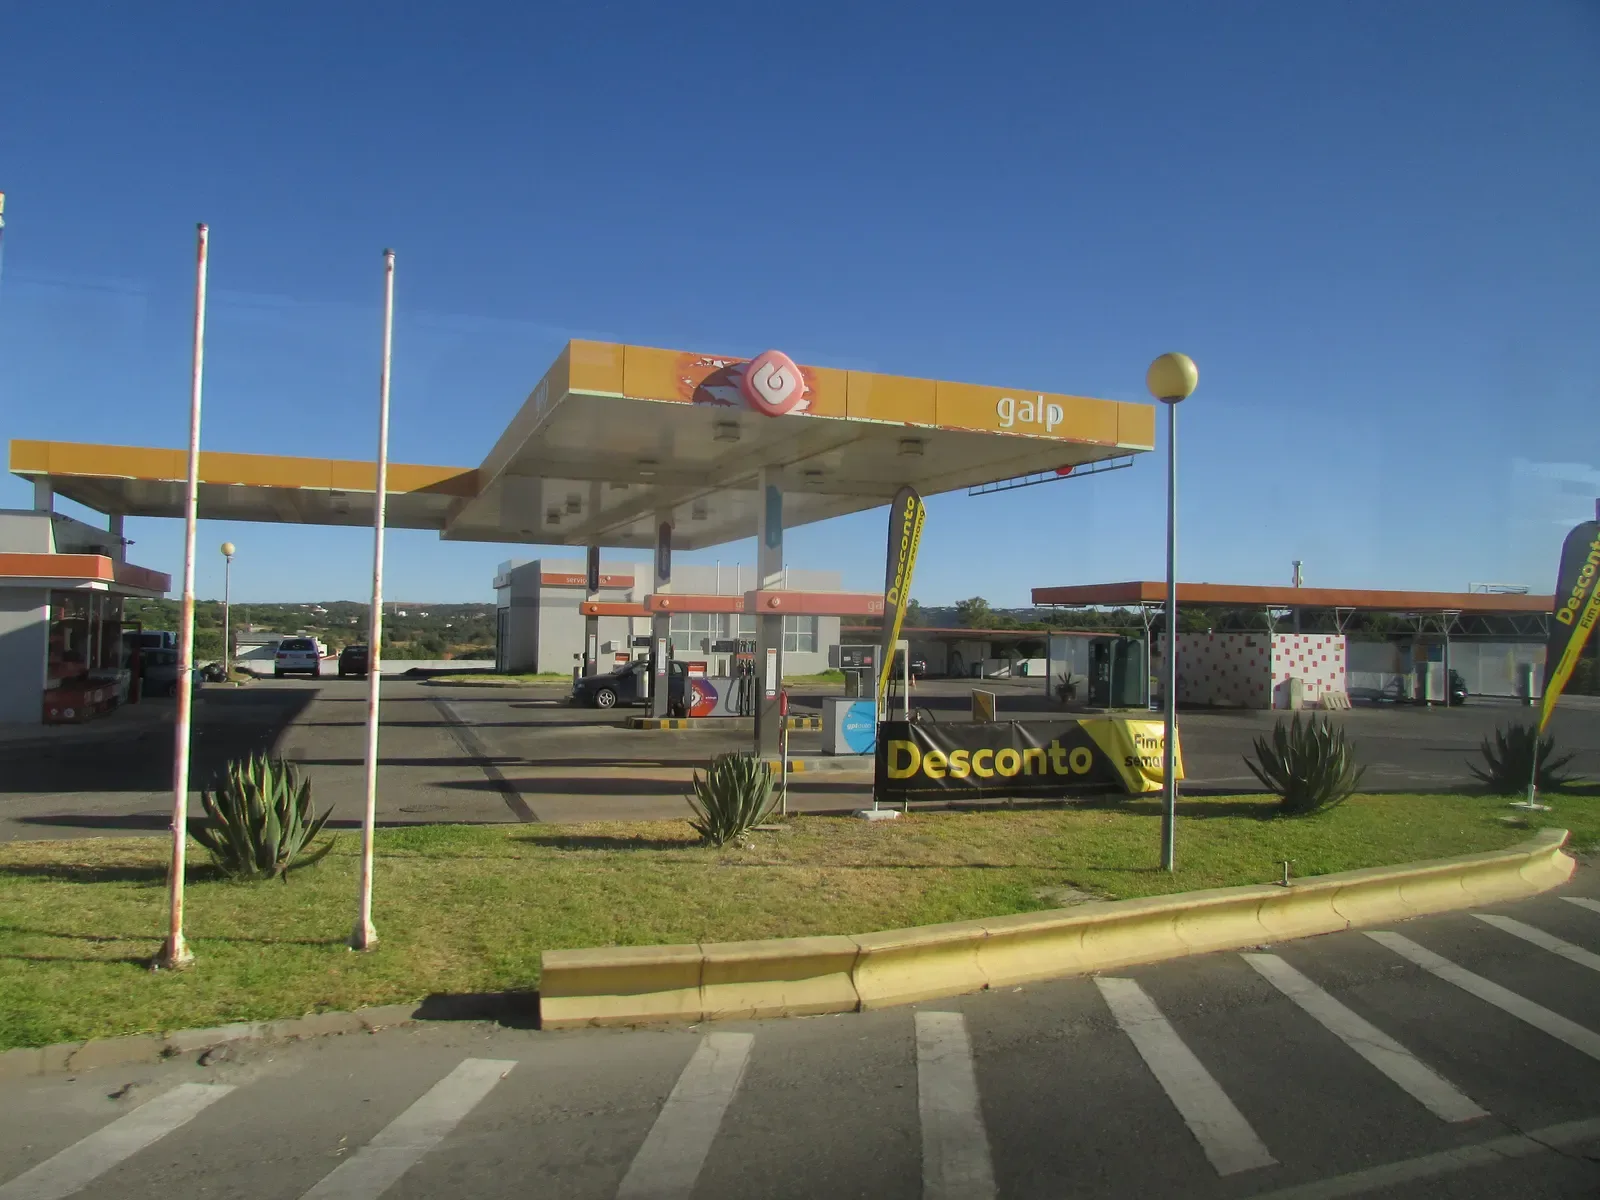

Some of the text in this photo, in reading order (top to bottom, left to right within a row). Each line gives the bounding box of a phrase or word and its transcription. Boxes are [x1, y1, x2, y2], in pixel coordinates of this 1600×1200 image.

[996, 395, 1064, 432] galp
[887, 496, 915, 606] Desconto
[566, 576, 589, 585] serviç
[867, 596, 885, 613] gal
[1580, 604, 1597, 629] Fim
[1134, 733, 1158, 749] Fim
[887, 739, 1093, 779] Desconto
